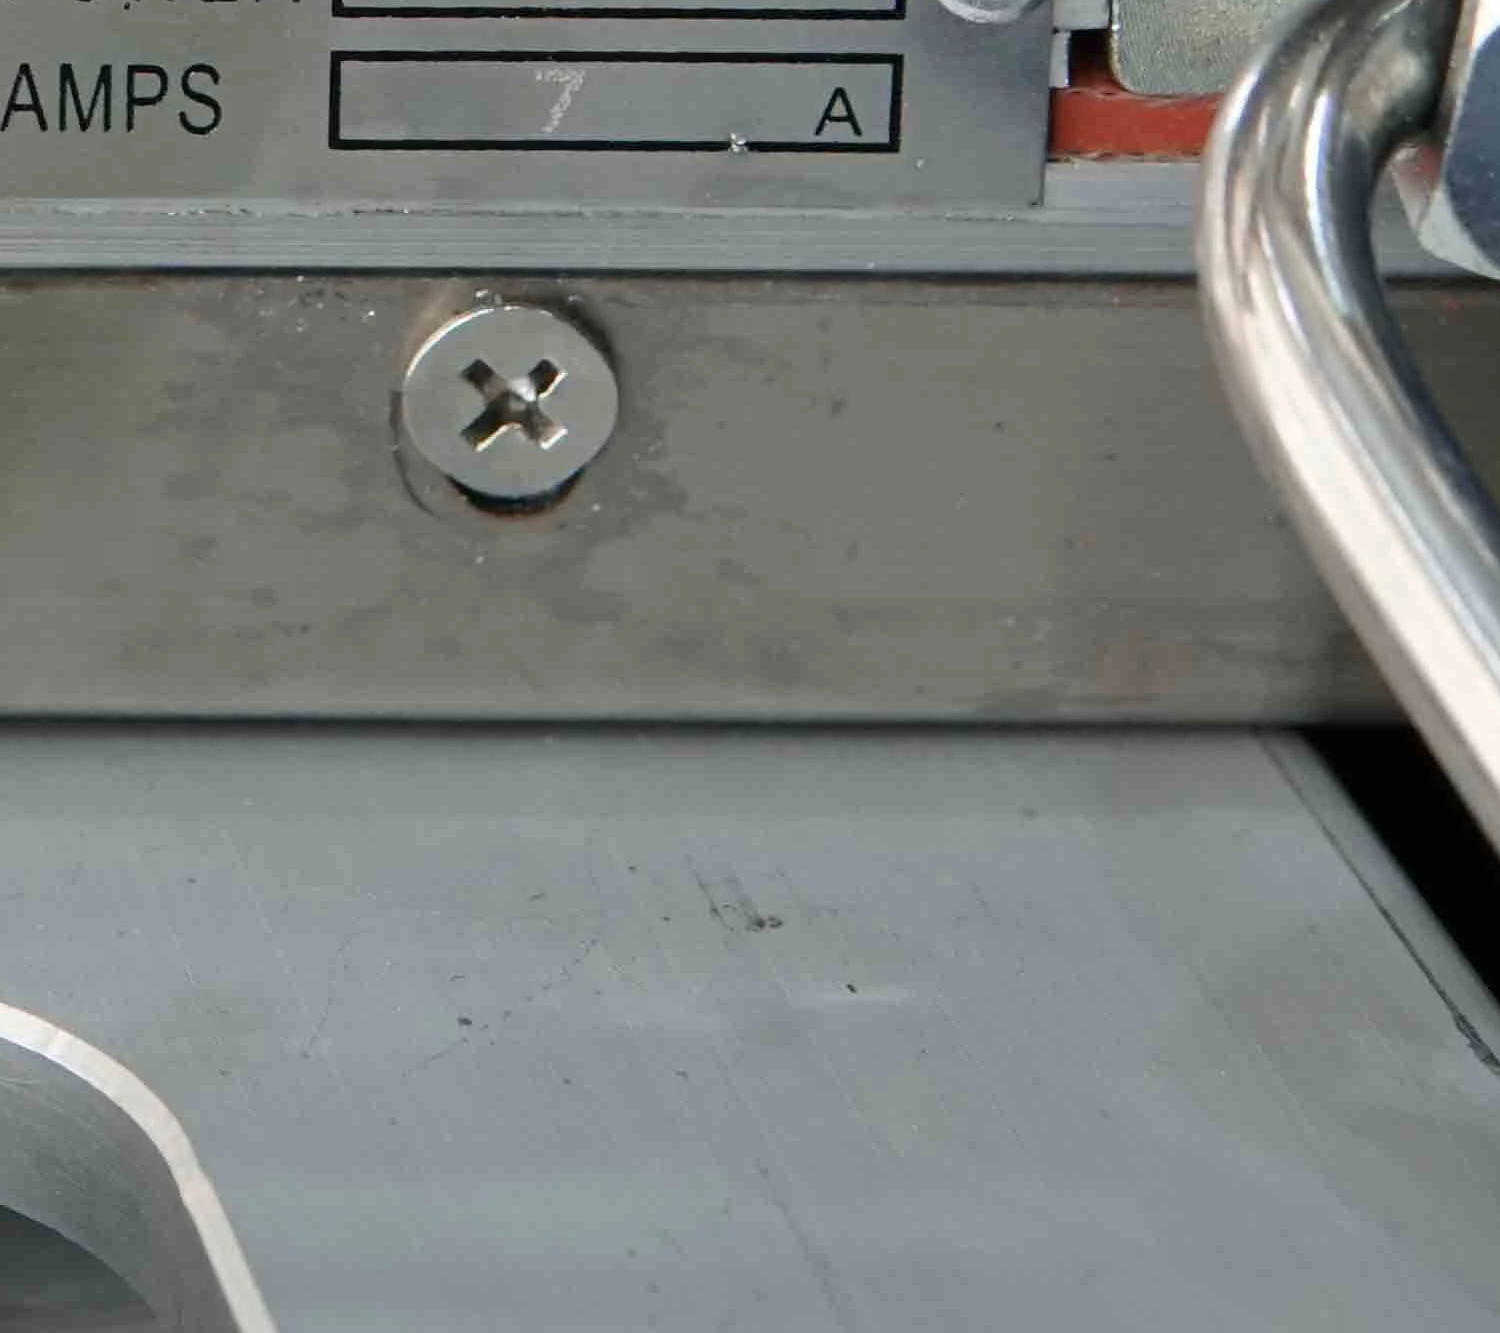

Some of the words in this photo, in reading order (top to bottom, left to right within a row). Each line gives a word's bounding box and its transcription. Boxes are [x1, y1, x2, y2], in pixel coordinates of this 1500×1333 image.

[0, 62, 224, 138] AMPS
[534, 66, 587, 135] 7
[815, 85, 864, 138] A
